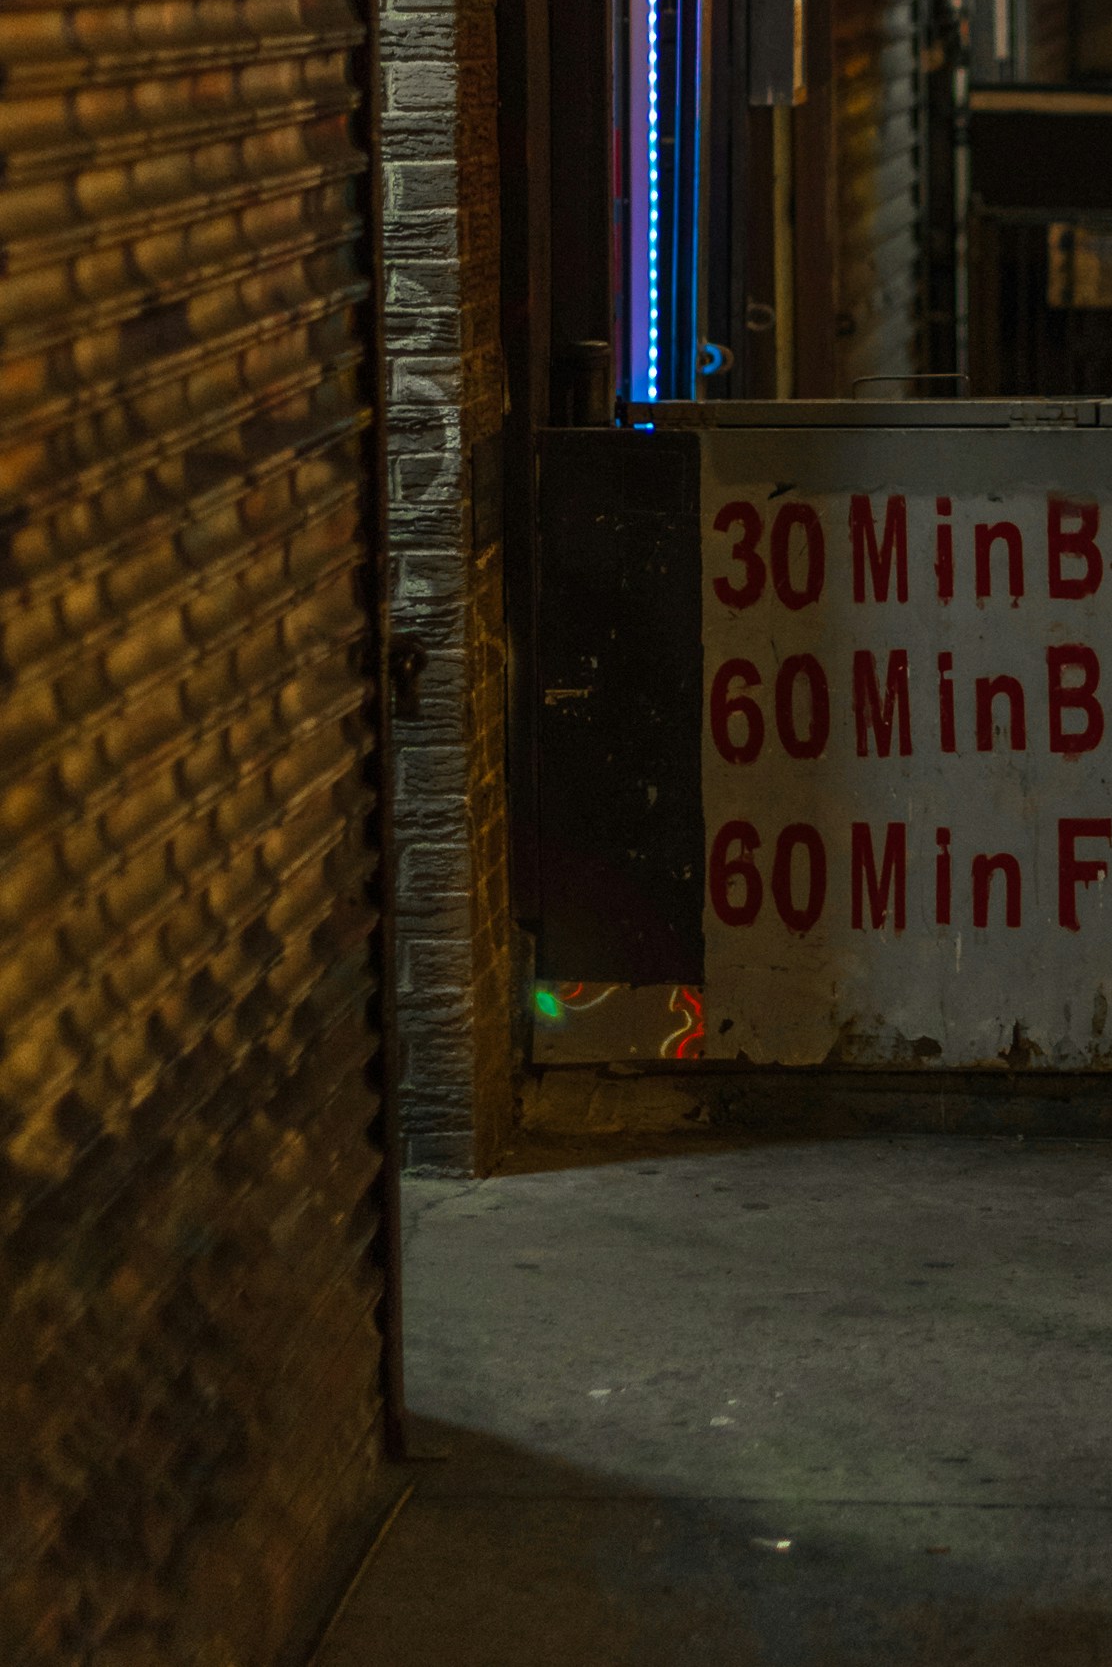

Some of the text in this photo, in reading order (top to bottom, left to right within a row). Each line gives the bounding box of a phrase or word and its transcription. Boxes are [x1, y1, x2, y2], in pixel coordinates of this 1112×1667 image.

[712, 499, 827, 610] 30
[710, 653, 831, 765] 60
[710, 819, 828, 930] 60
